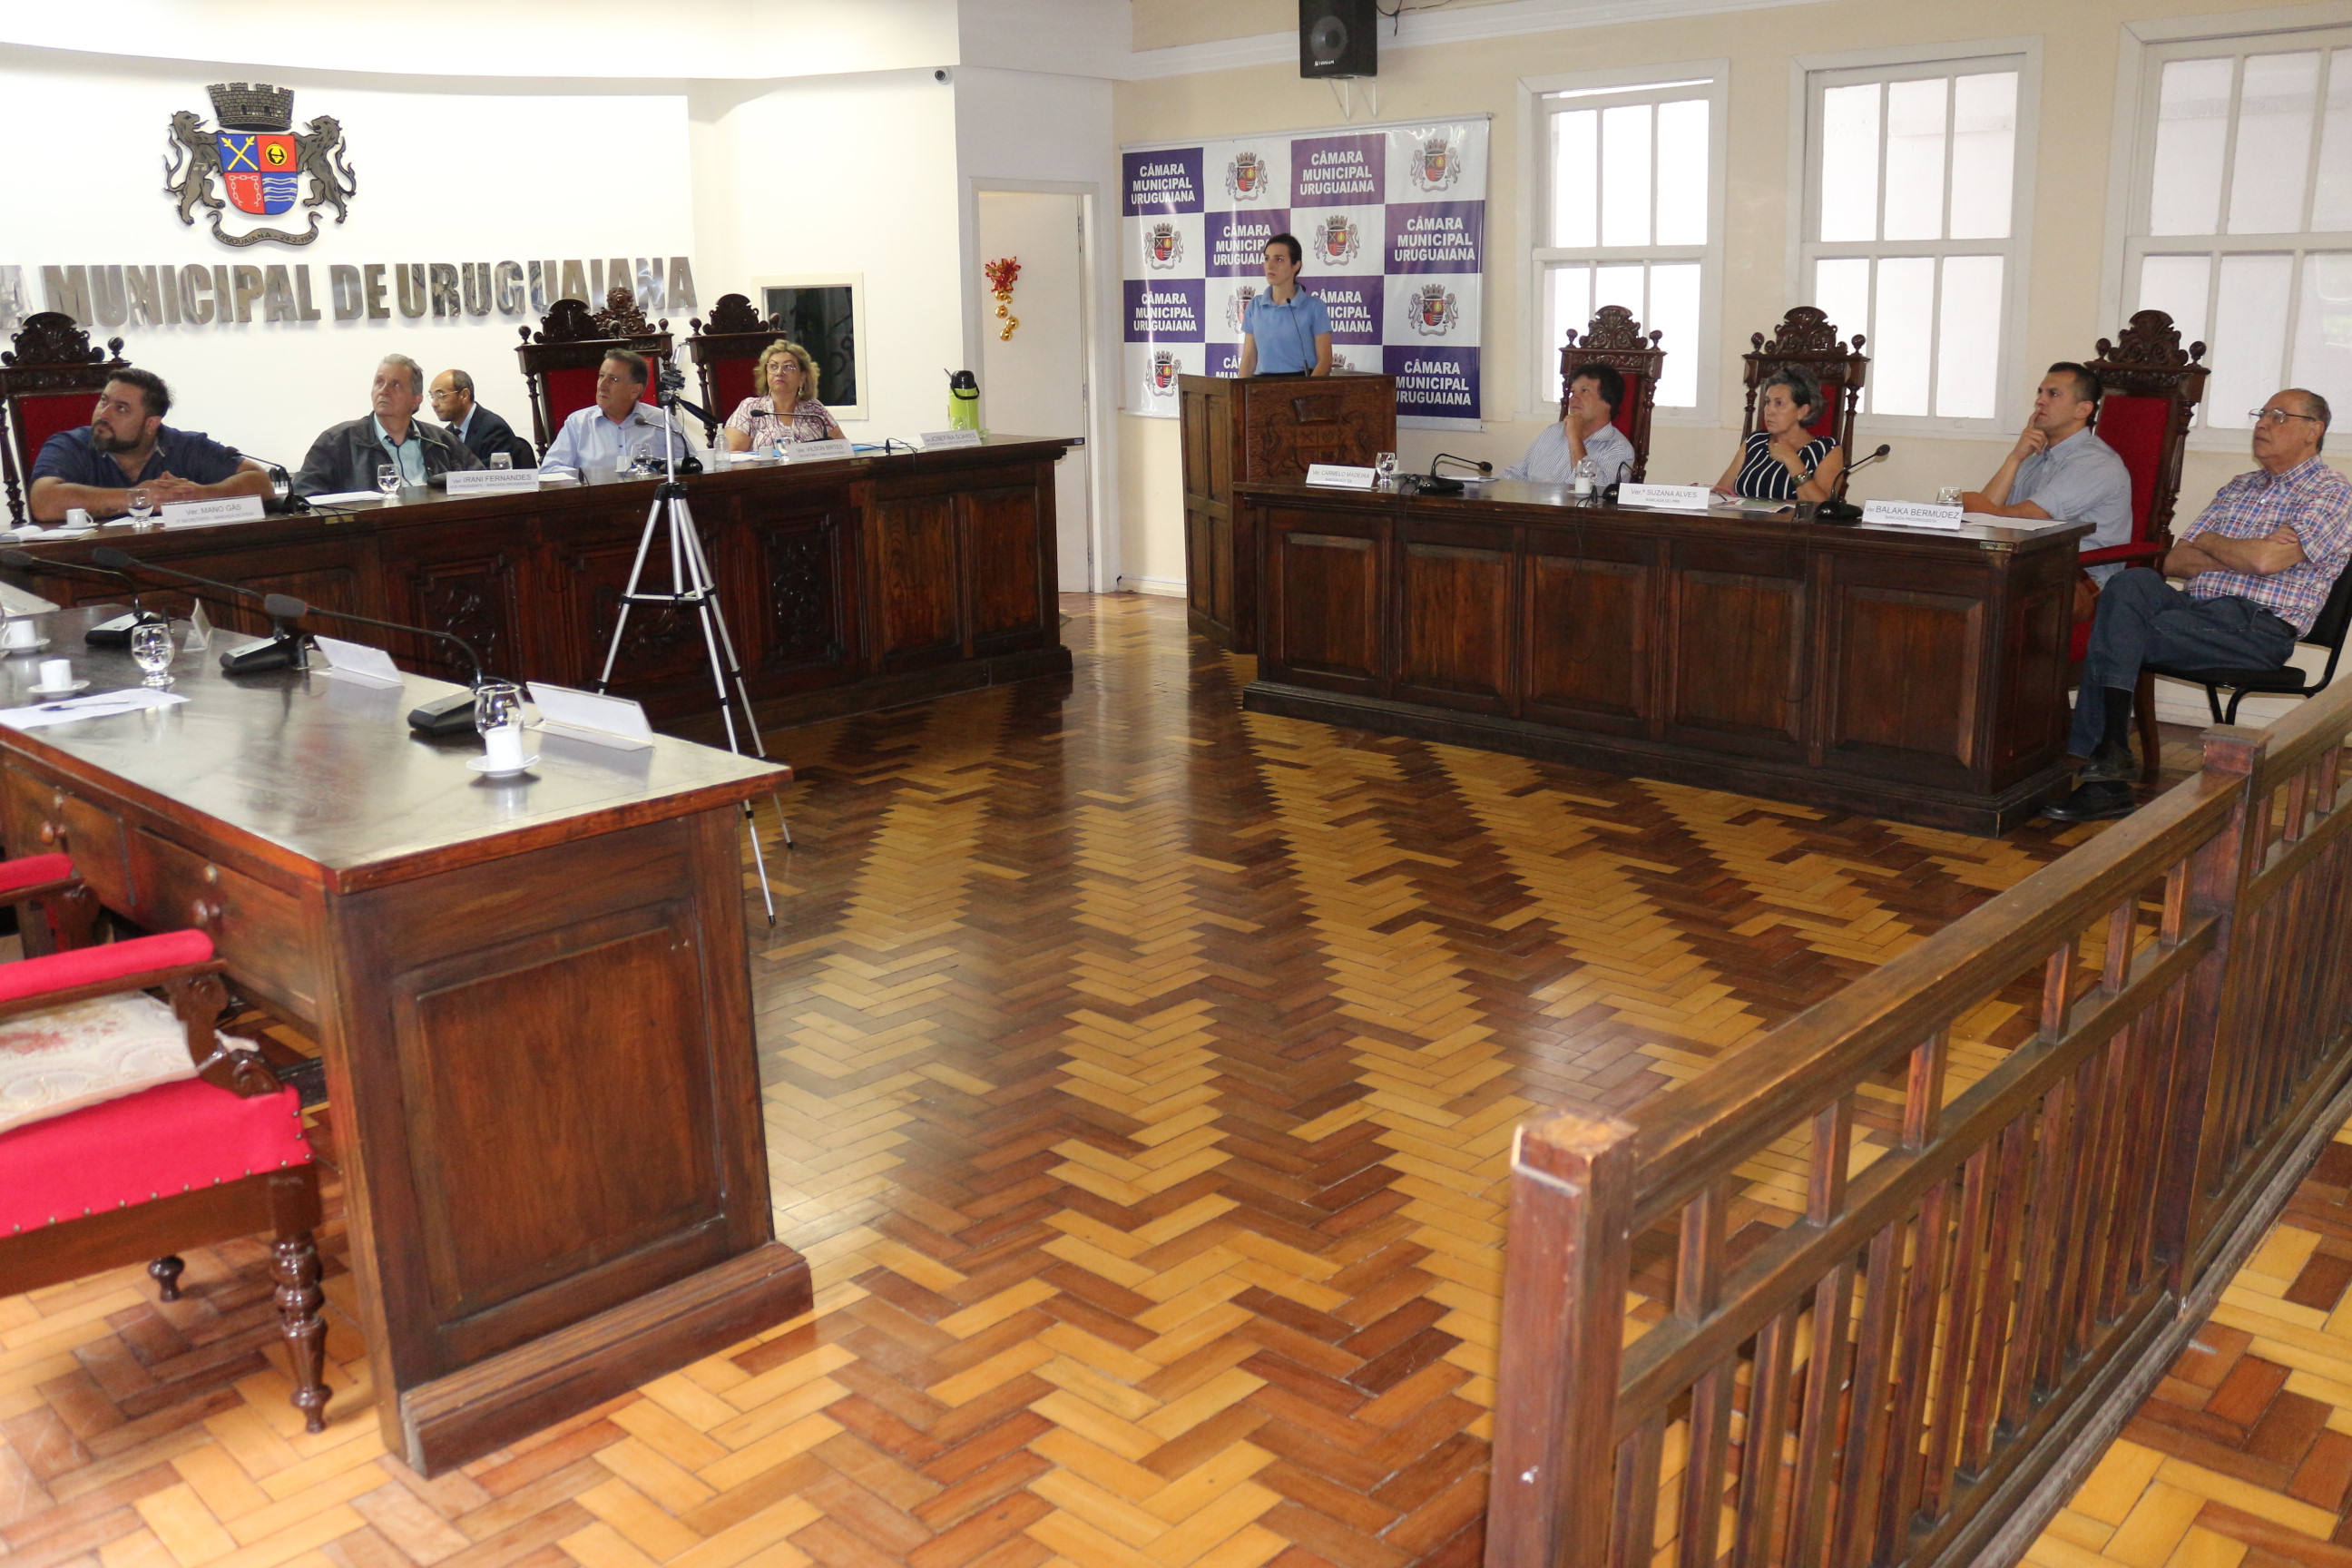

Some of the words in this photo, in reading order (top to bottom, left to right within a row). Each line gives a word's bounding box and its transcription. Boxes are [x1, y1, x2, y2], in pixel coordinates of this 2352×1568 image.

[1311, 151, 1364, 165] CÂMARA
[1140, 163, 1185, 177] CÂMARA
[1302, 166, 1372, 181] MUNICIPAL
[1133, 177, 1192, 191] MUNICIPAL
[1299, 181, 1375, 195] URUGUAIANA
[1132, 191, 1195, 204] URUGUAIANA
[1223, 222, 1271, 237] CÂMARA
[1406, 216, 1463, 231] CÂMARA
[216, 230, 271, 244] URUGUAIANA
[1397, 233, 1473, 247] MUNICIPAL
[1216, 239, 1269, 252] MUNICIP
[1213, 253, 1265, 265] URUGUAIA
[1394, 248, 1475, 261] URUGUAIANA
[38, 264, 321, 327] MUNICIPAL
[328, 263, 390, 320] DE
[394, 257, 698, 318] URUGUAIANA
[1142, 290, 1187, 304] CÂMARA
[1135, 307, 1194, 318] MUNICIPAL
[1327, 306, 1371, 318] ICIPAL
[1133, 320, 1197, 332] URUGUAIANA
[1330, 320, 1373, 332] UAIANA
[1405, 358, 1460, 375] CÂMARA
[1396, 377, 1469, 390] MUNICIPAL
[485, 474, 532, 482] FERNANDES
[1646, 489, 1674, 497] SUZANA
[201, 505, 224, 514] MANO
[1876, 505, 1908, 514] BALAKA
[1910, 508, 1959, 519] BERMÚDEZ
